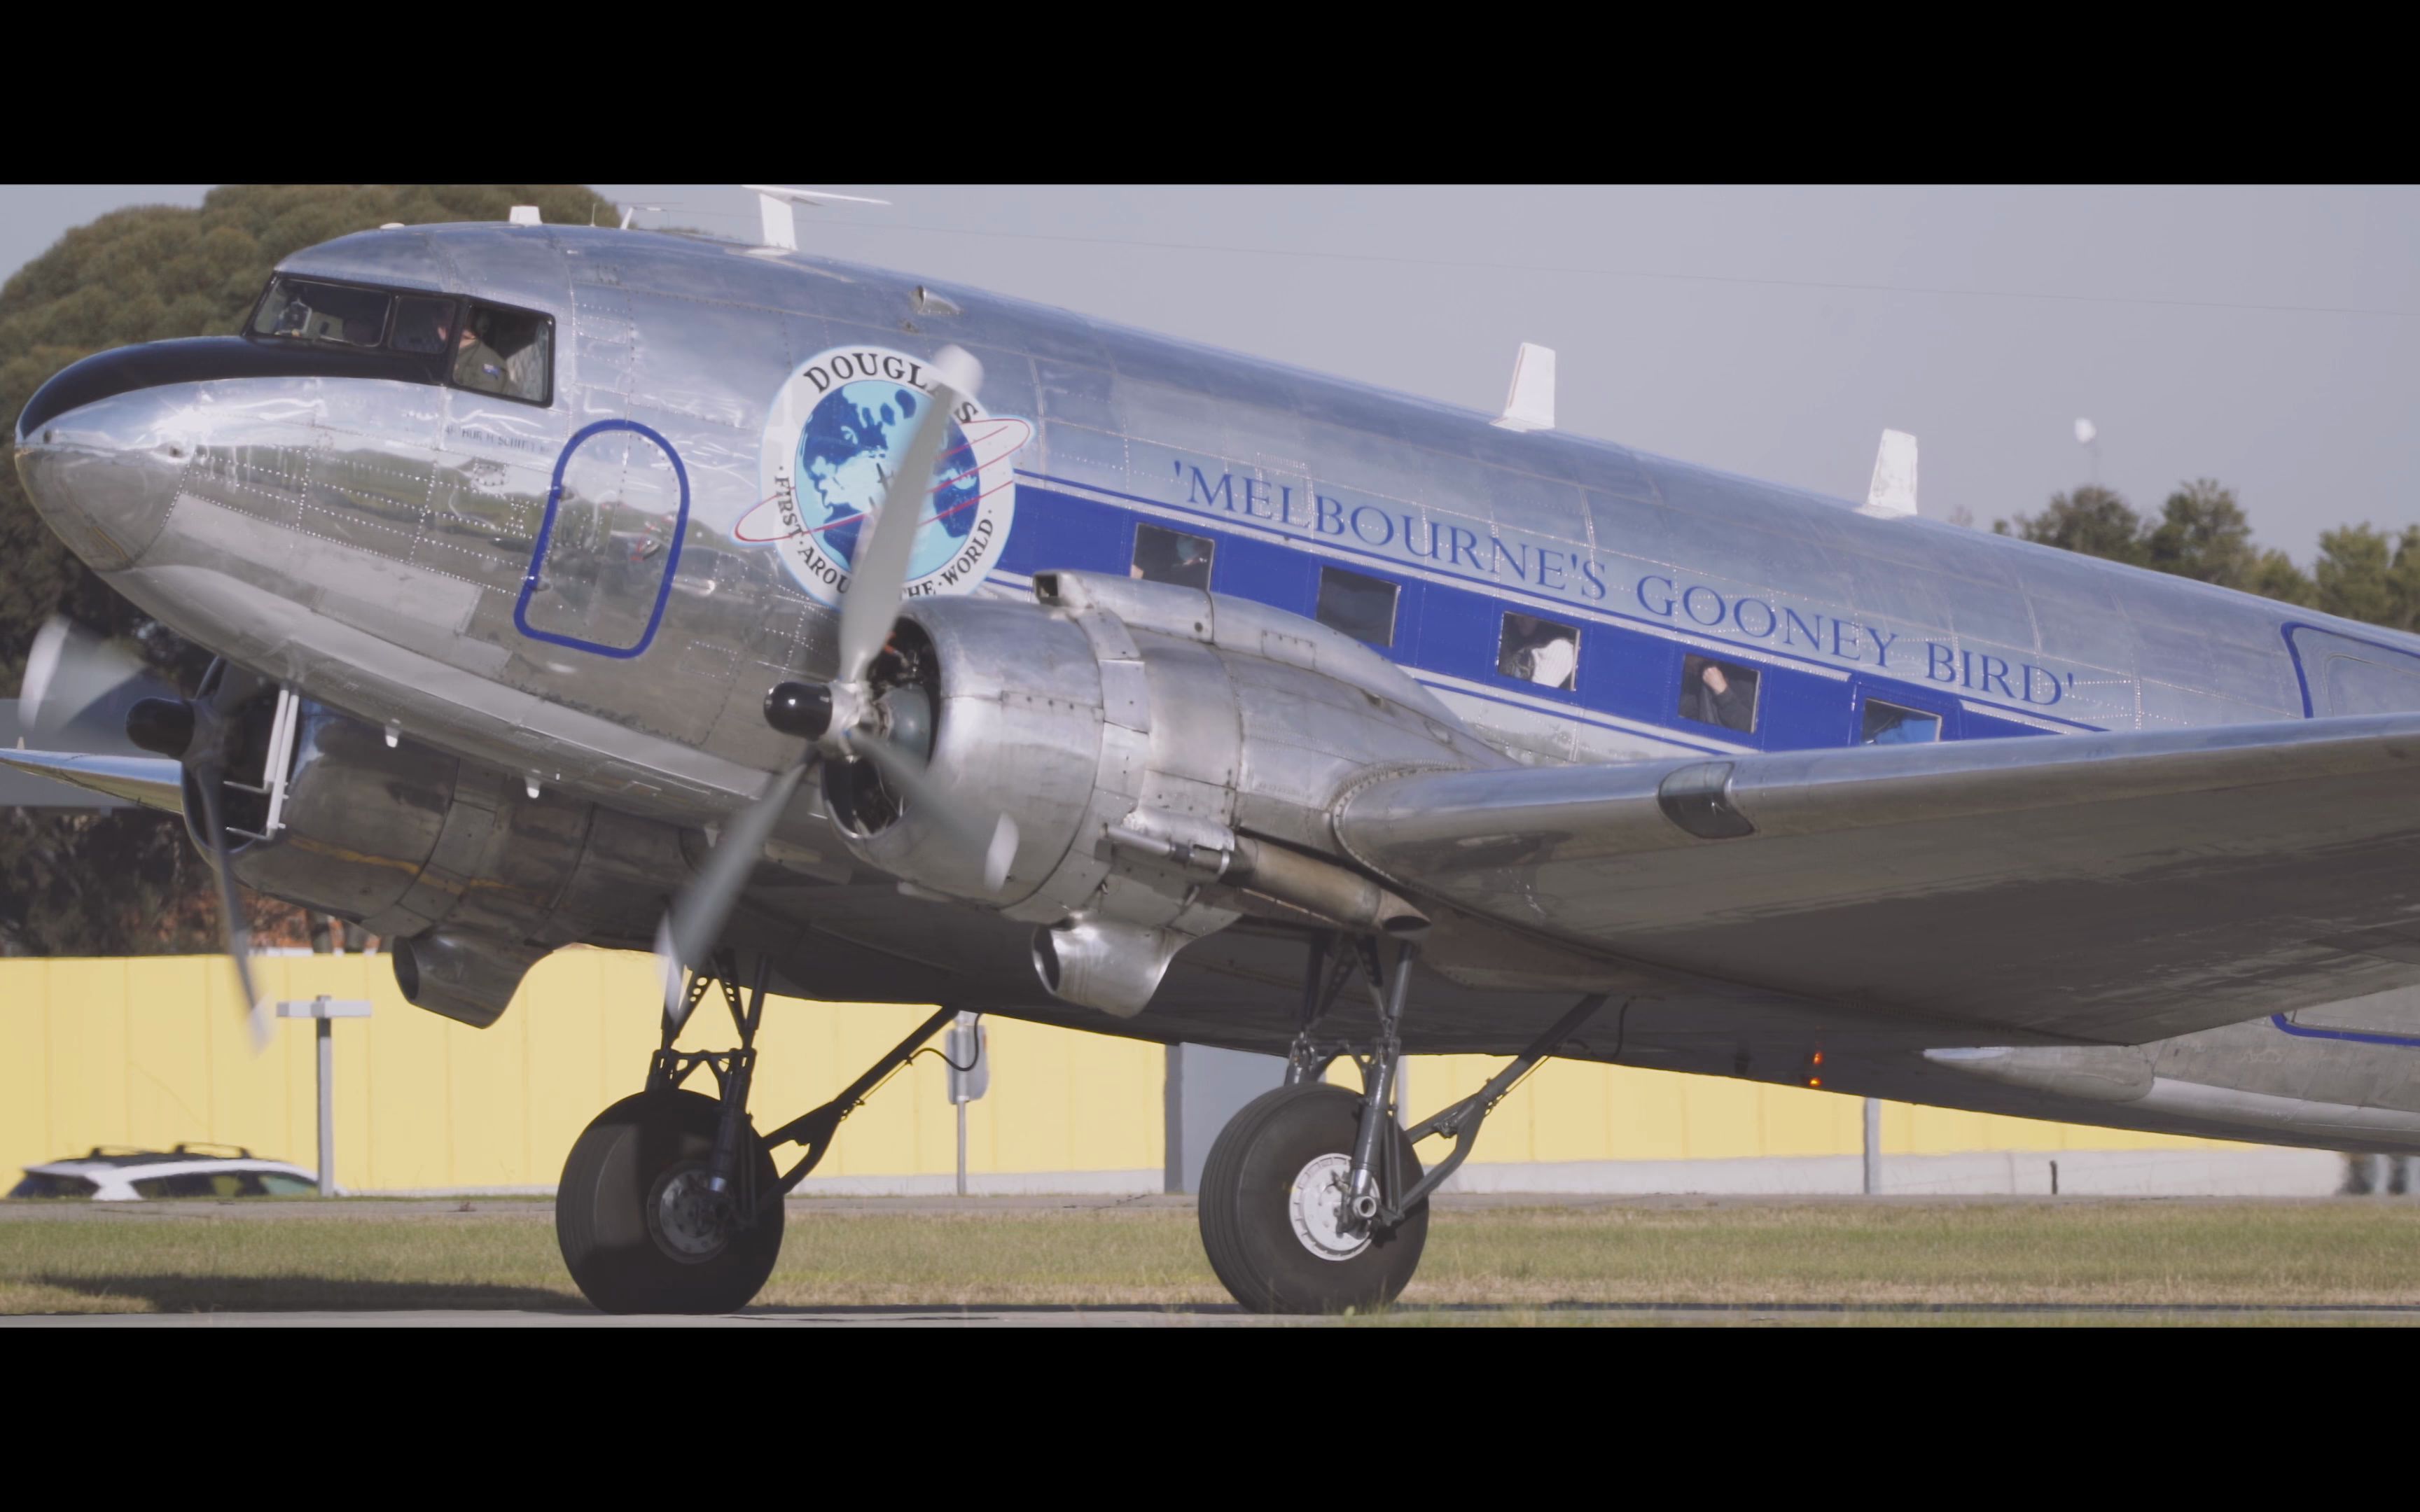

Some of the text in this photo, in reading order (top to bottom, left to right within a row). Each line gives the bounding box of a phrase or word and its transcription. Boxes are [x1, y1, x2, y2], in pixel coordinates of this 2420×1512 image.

[803, 353, 979, 424] DOUGLS
[774, 476, 805, 540] FIRST
[798, 546, 851, 594] AROU
[940, 519, 994, 587] WORLD
[1174, 459, 2073, 706] 'MELBOURNE'S GOONEY BIRD'
